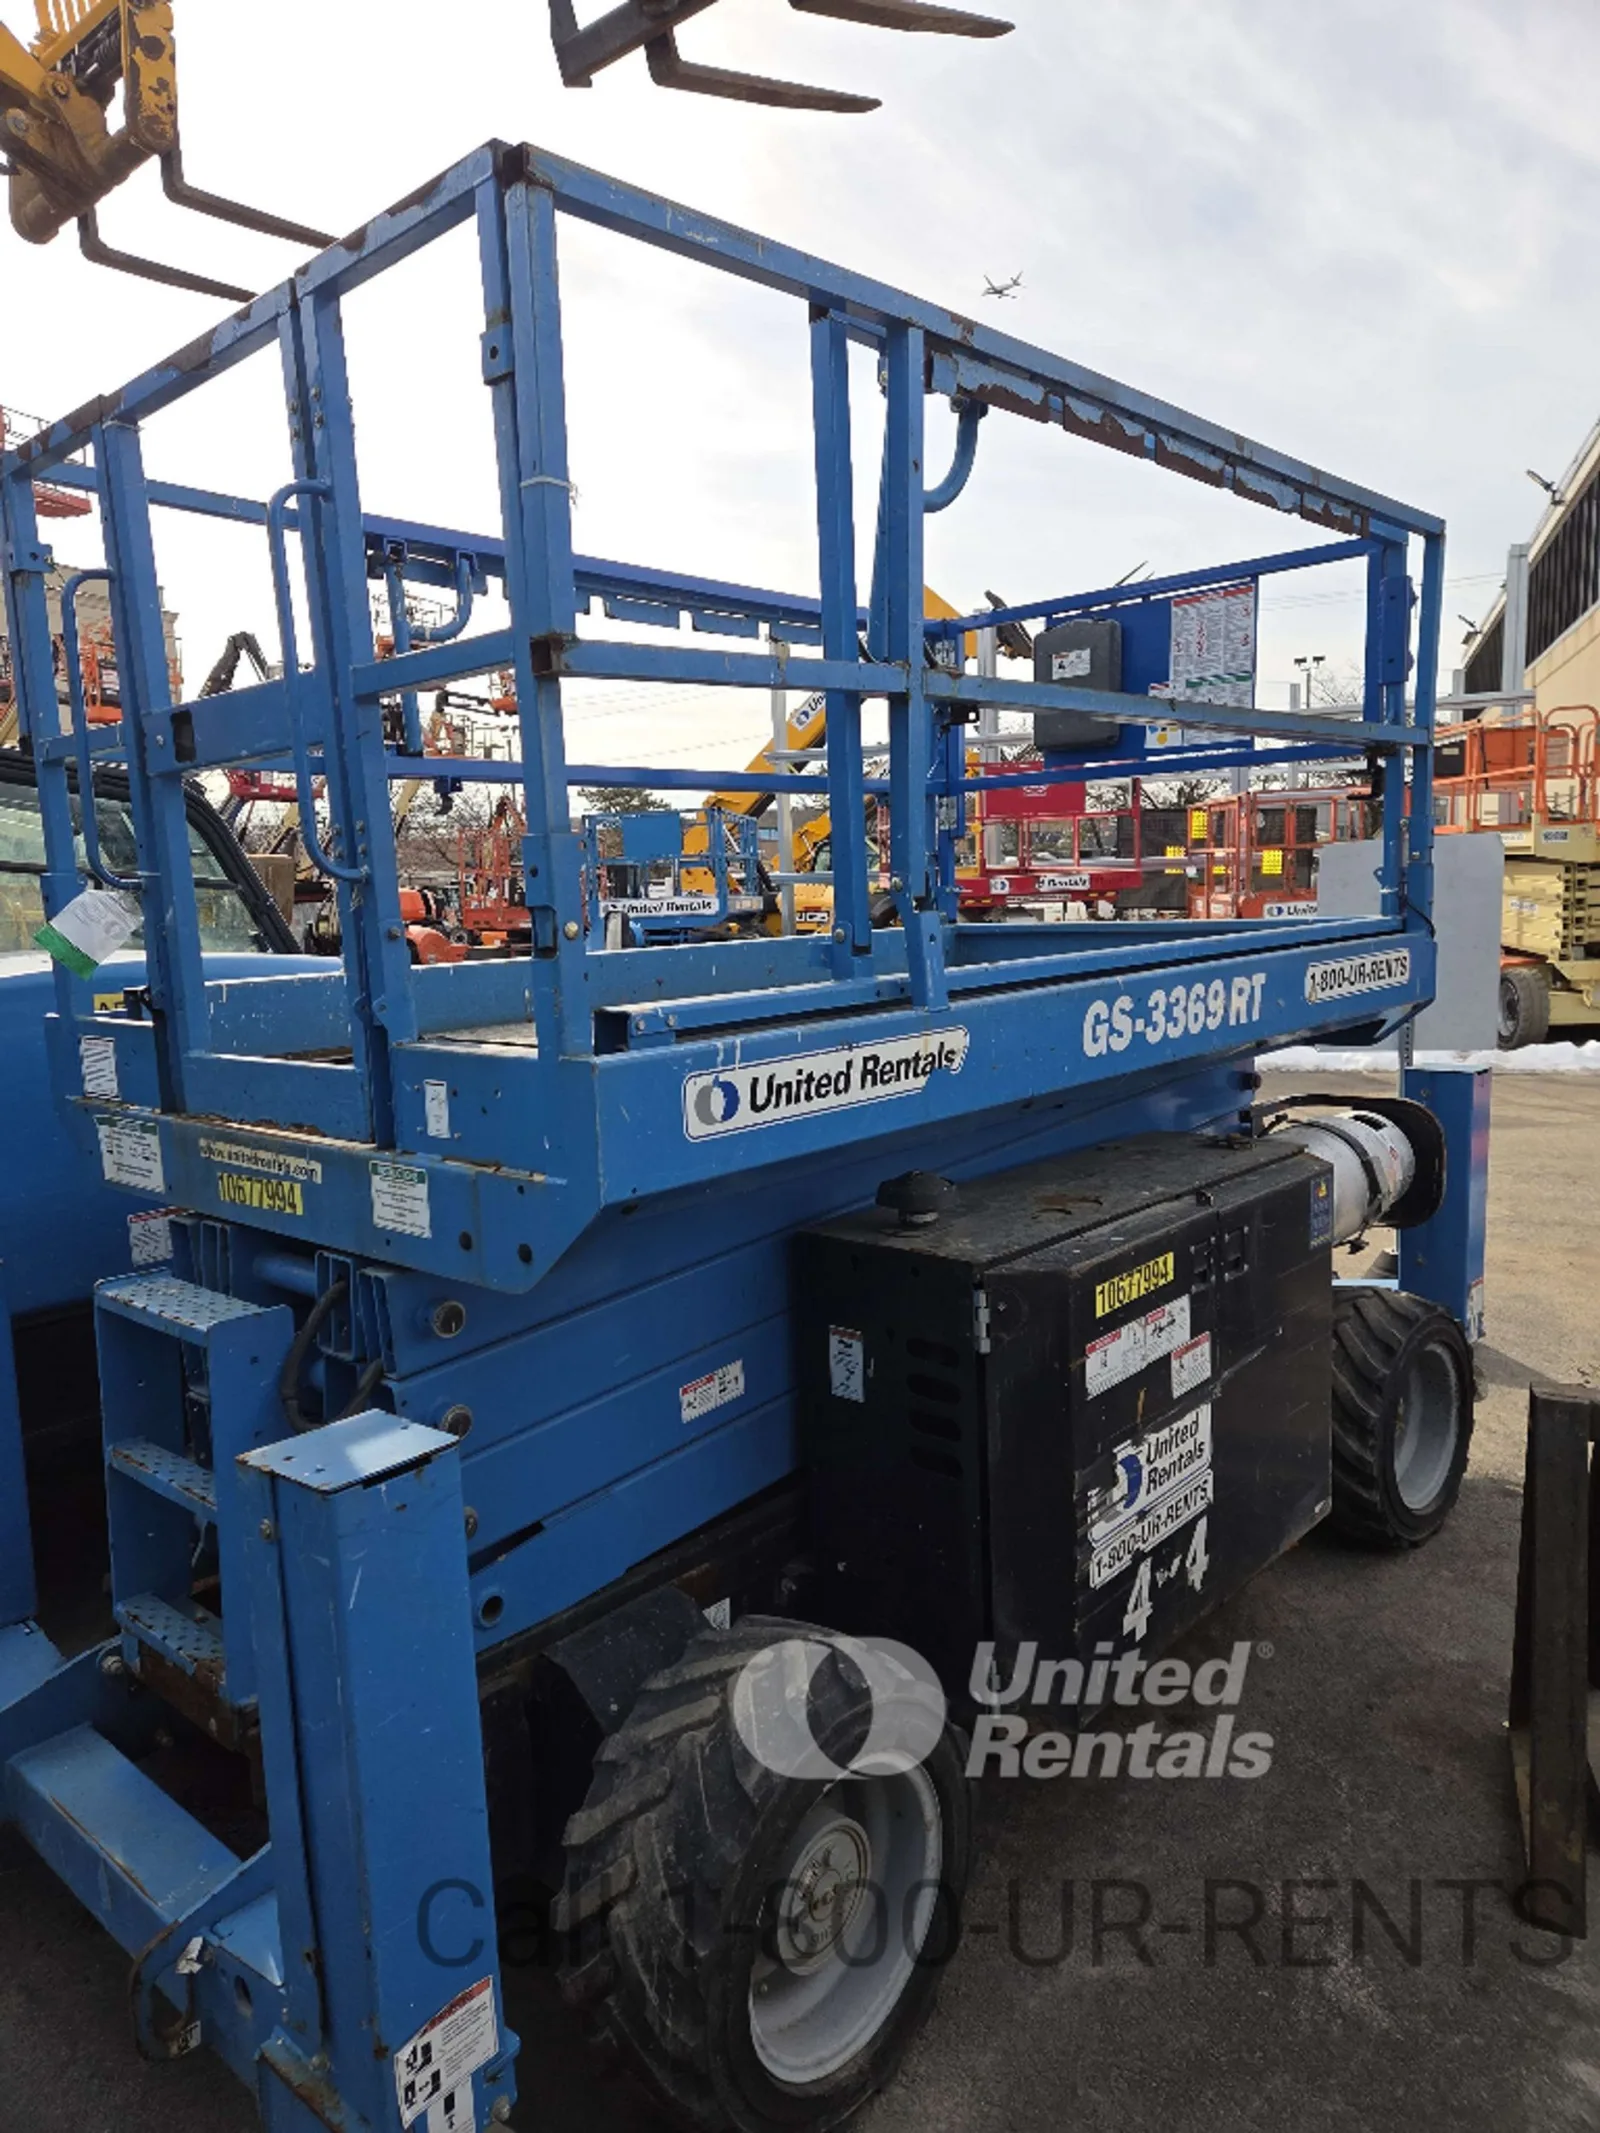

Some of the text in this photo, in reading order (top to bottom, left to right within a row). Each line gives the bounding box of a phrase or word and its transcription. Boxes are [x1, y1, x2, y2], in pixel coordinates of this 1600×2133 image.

[1310, 955, 1408, 993] 1-800-UR-RENTS
[750, 1041, 958, 1114] United Rentals
[218, 1172, 298, 1213] 10677994
[1098, 1255, 1170, 1314] 10677994
[1145, 1411, 1200, 1466] United
[1145, 1438, 1206, 1497] Rentals
[1095, 1478, 1211, 1578] 1-800-UR-RENTS
